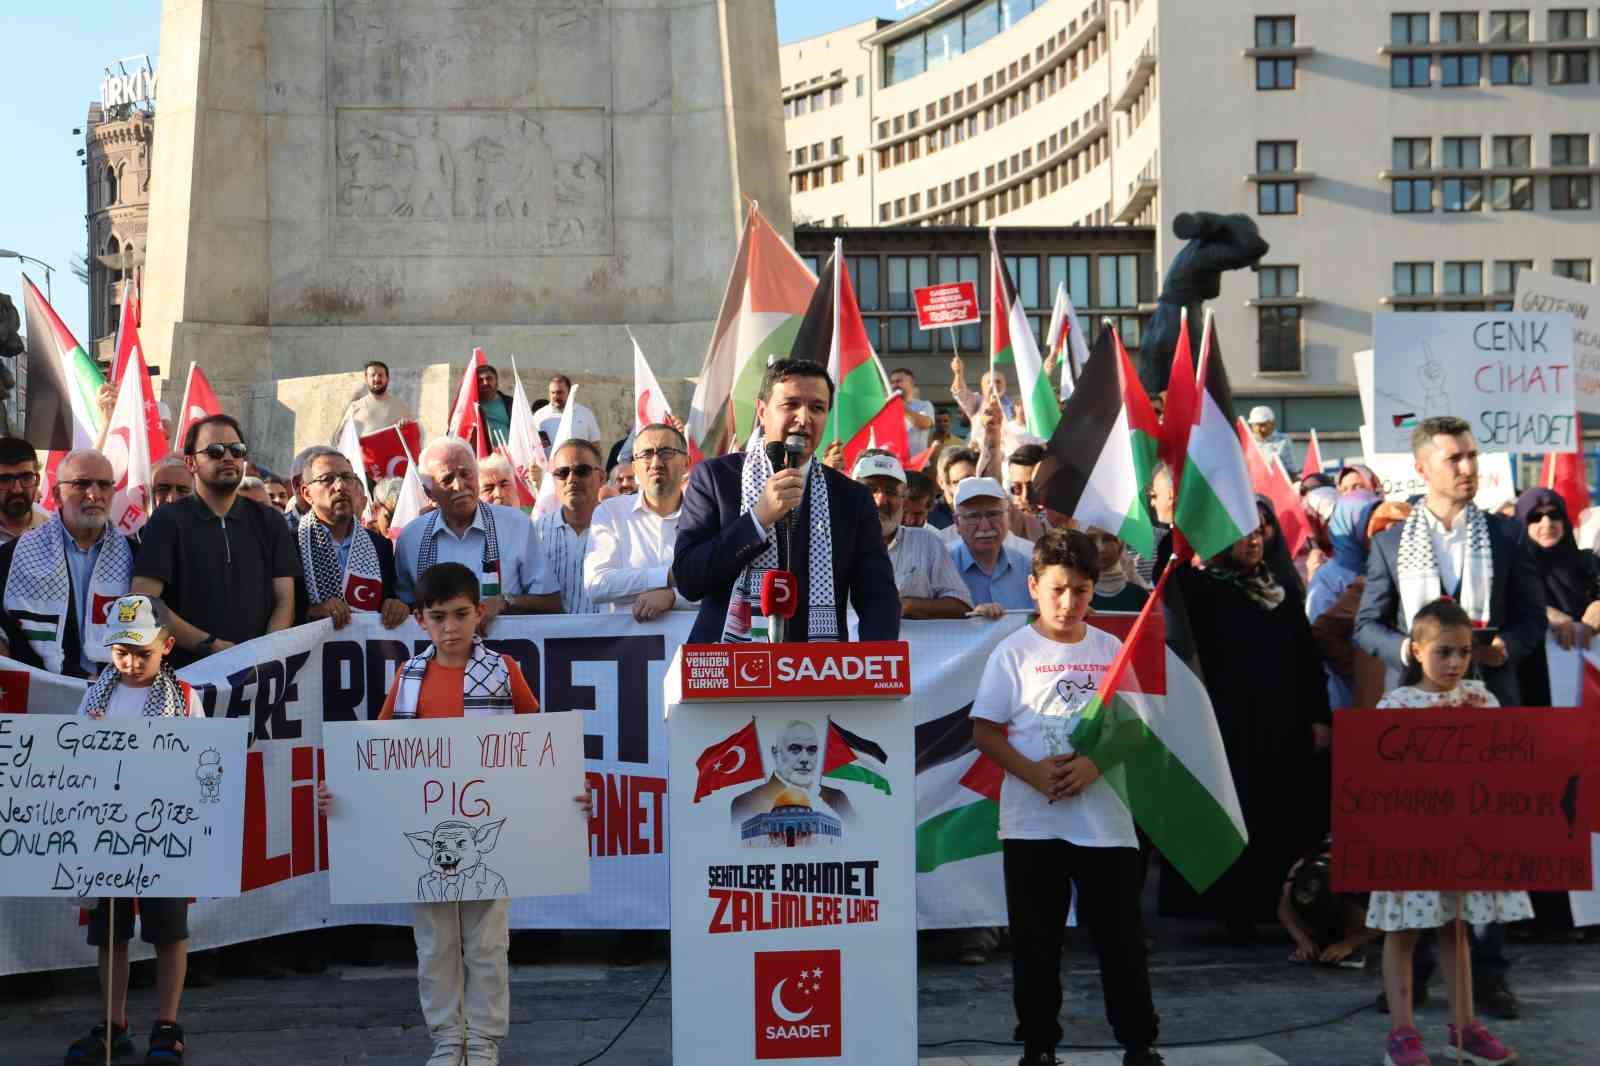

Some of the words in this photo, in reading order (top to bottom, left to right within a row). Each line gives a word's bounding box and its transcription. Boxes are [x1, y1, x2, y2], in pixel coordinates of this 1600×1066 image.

[1473, 321, 1549, 352] CENK
[774, 578, 791, 602] 5
[776, 656, 903, 682] SAADET
[1035, 664, 1065, 673] HELLO
[873, 681, 904, 689] ANKARA
[0, 719, 34, 768] Ey
[356, 735, 451, 771] NETANYAHU
[477, 731, 532, 768] YOU'RE
[539, 731, 556, 768] A
[423, 779, 490, 817] PIG
[587, 772, 668, 857] ANET
[0, 828, 78, 857] ONLAR
[51, 863, 161, 898] Diyecekler
[781, 860, 879, 897] RAHMET
[846, 898, 880, 924] LANET
[765, 1024, 831, 1040] SAADET
